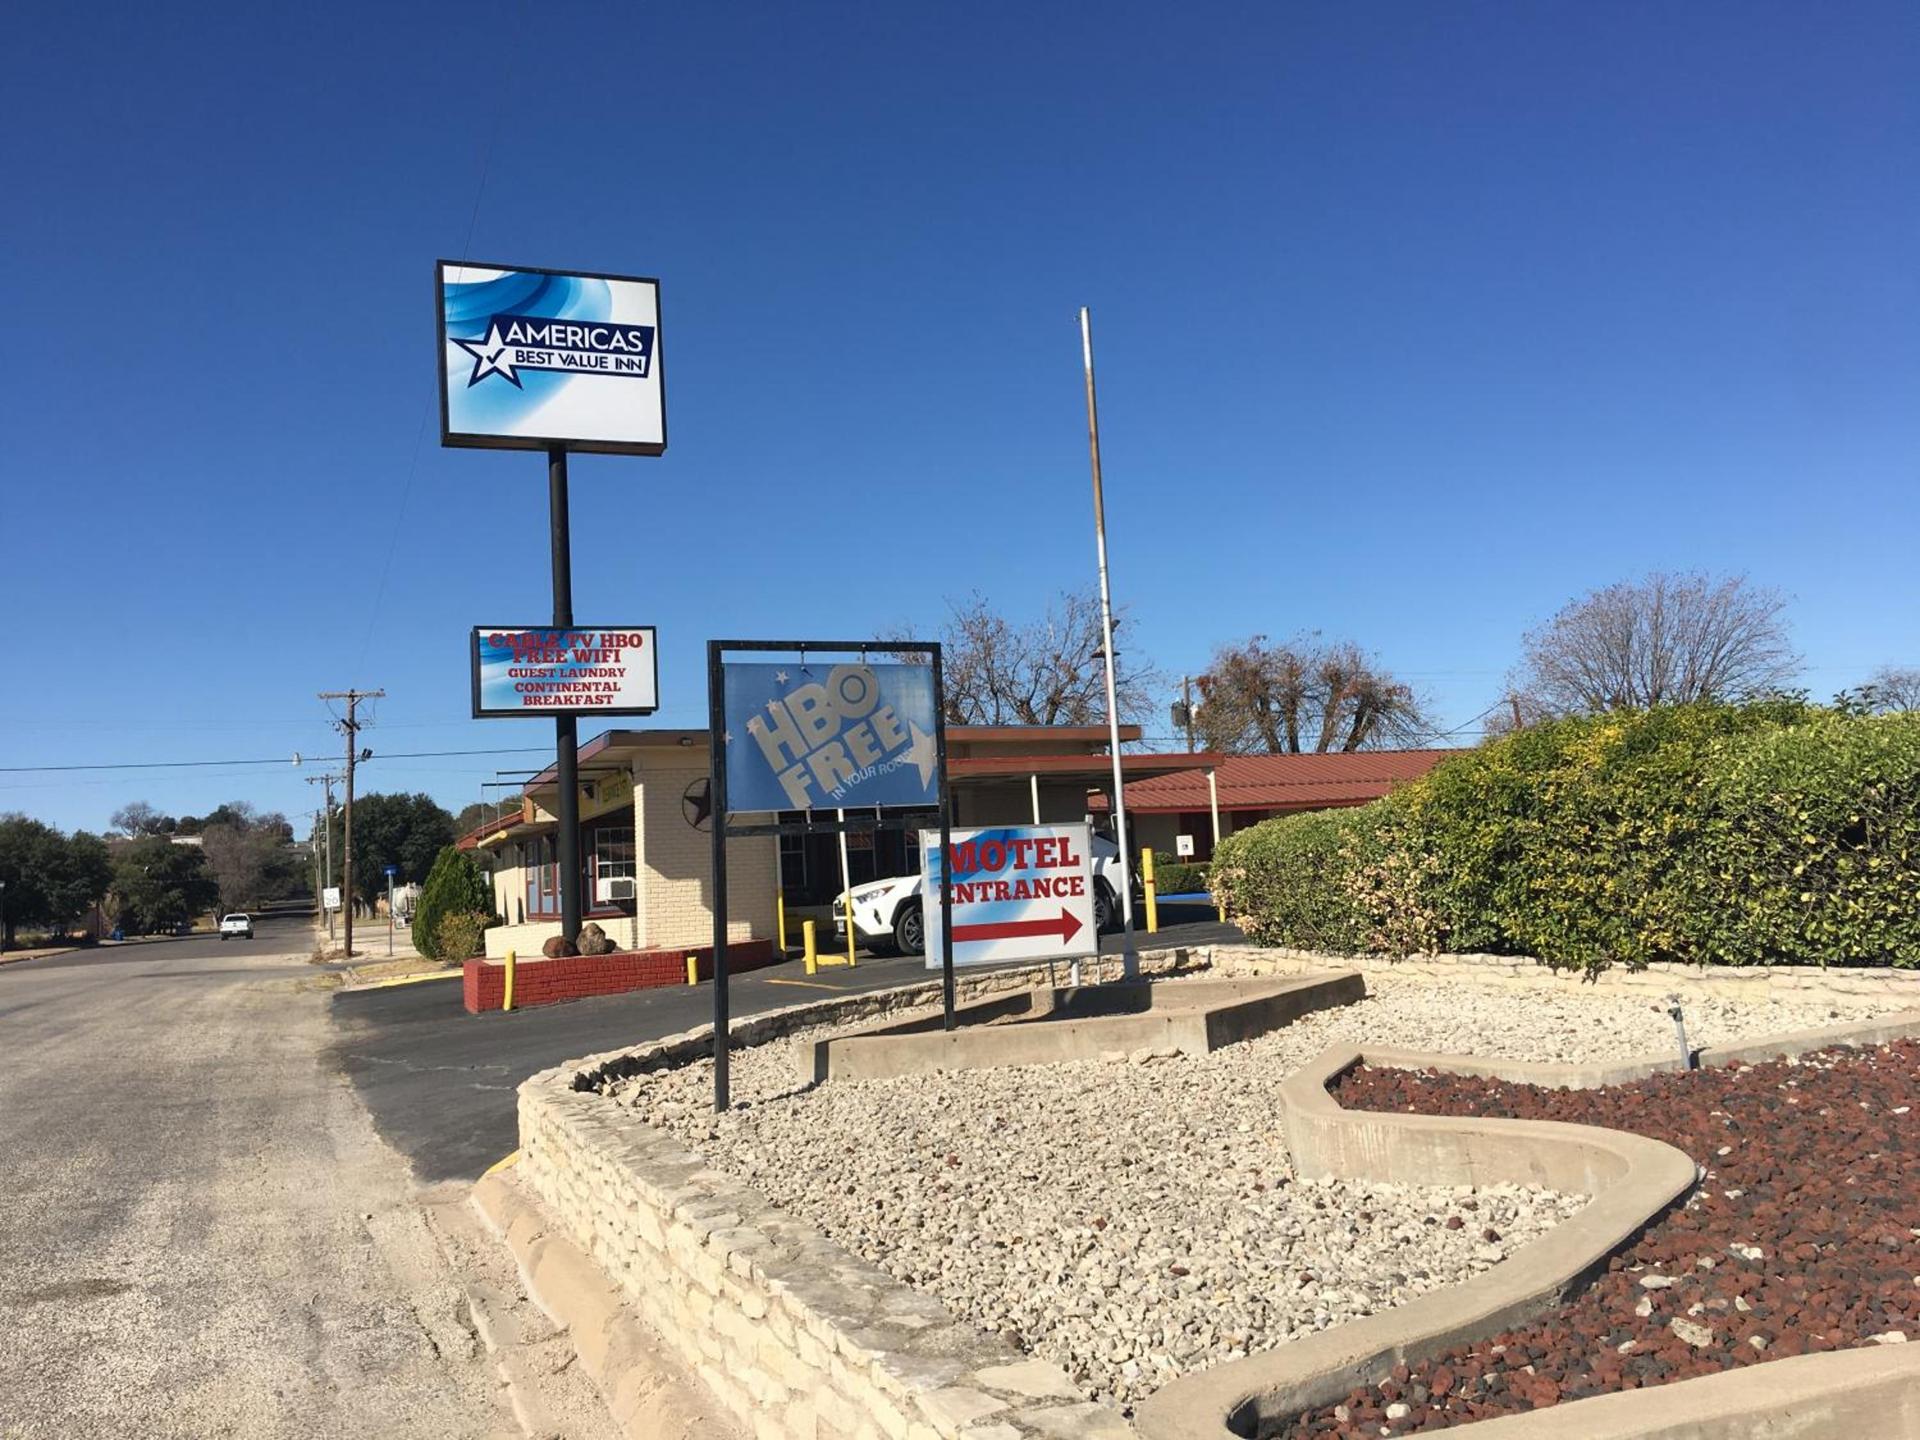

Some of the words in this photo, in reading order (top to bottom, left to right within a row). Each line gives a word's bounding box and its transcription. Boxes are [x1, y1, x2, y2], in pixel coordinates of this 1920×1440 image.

[505, 321, 643, 352] AMERICAS
[515, 350, 555, 366] BEST
[558, 353, 609, 369] VALUE
[615, 356, 643, 371] INN
[488, 632, 560, 649] CABLE
[564, 633, 594, 649] TV
[599, 633, 643, 649] HBO
[512, 648, 568, 664] FREE
[573, 648, 622, 664] WIFI
[508, 667, 556, 679] GUEST
[560, 667, 627, 679] LAUNDRY
[514, 681, 622, 694] CONTINENTAL
[523, 694, 614, 706] BREAKFAST
[752, 664, 879, 774] HBO
[778, 704, 909, 810] FREE
[832, 783, 847, 801] IN
[843, 766, 877, 788] YOUR
[942, 836, 1080, 874] MOTEL
